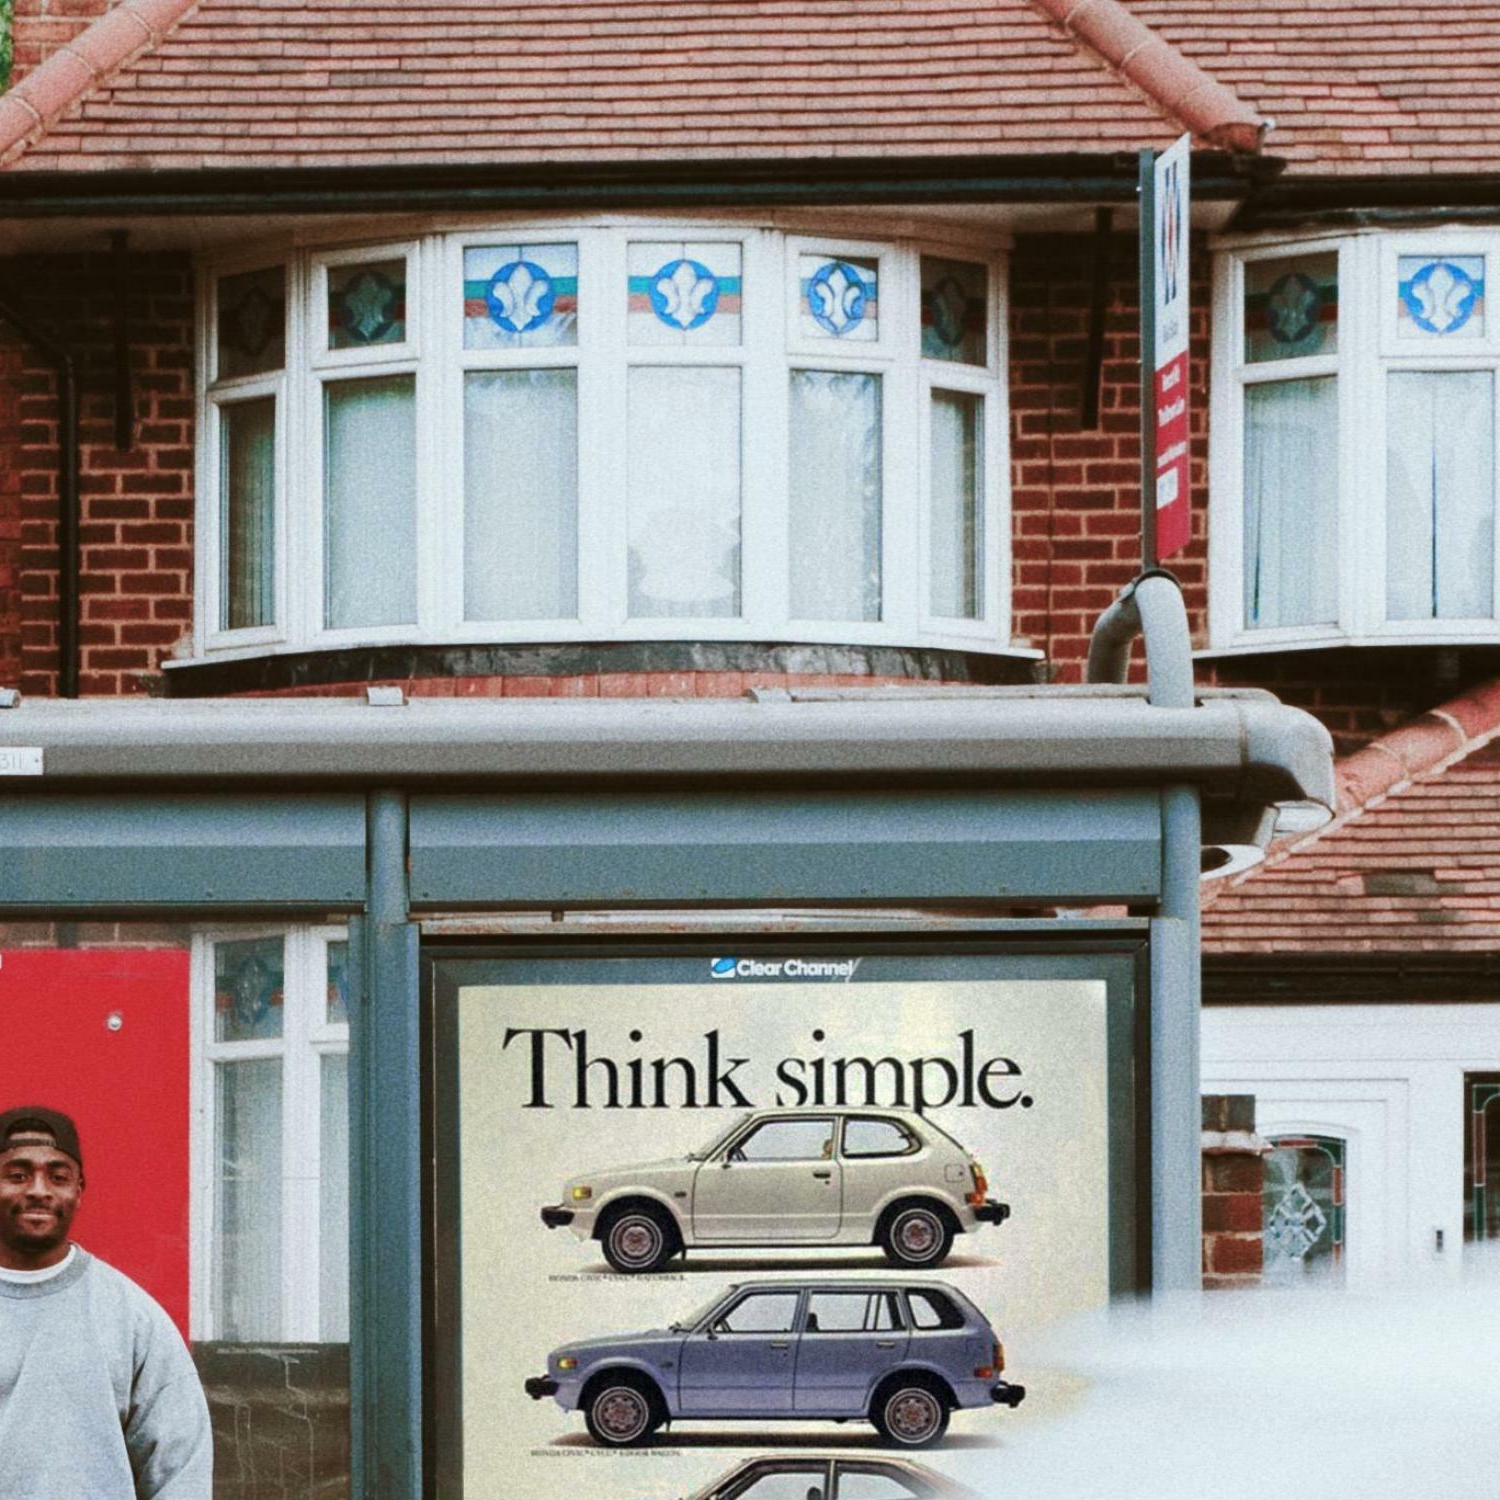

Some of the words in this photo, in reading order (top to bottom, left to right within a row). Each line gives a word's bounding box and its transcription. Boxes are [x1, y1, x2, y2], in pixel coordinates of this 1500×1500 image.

[736, 959, 782, 976] Clear
[783, 958, 853, 976] Channel
[502, 1027, 756, 1109] Think
[776, 1028, 1034, 1114] simple.
